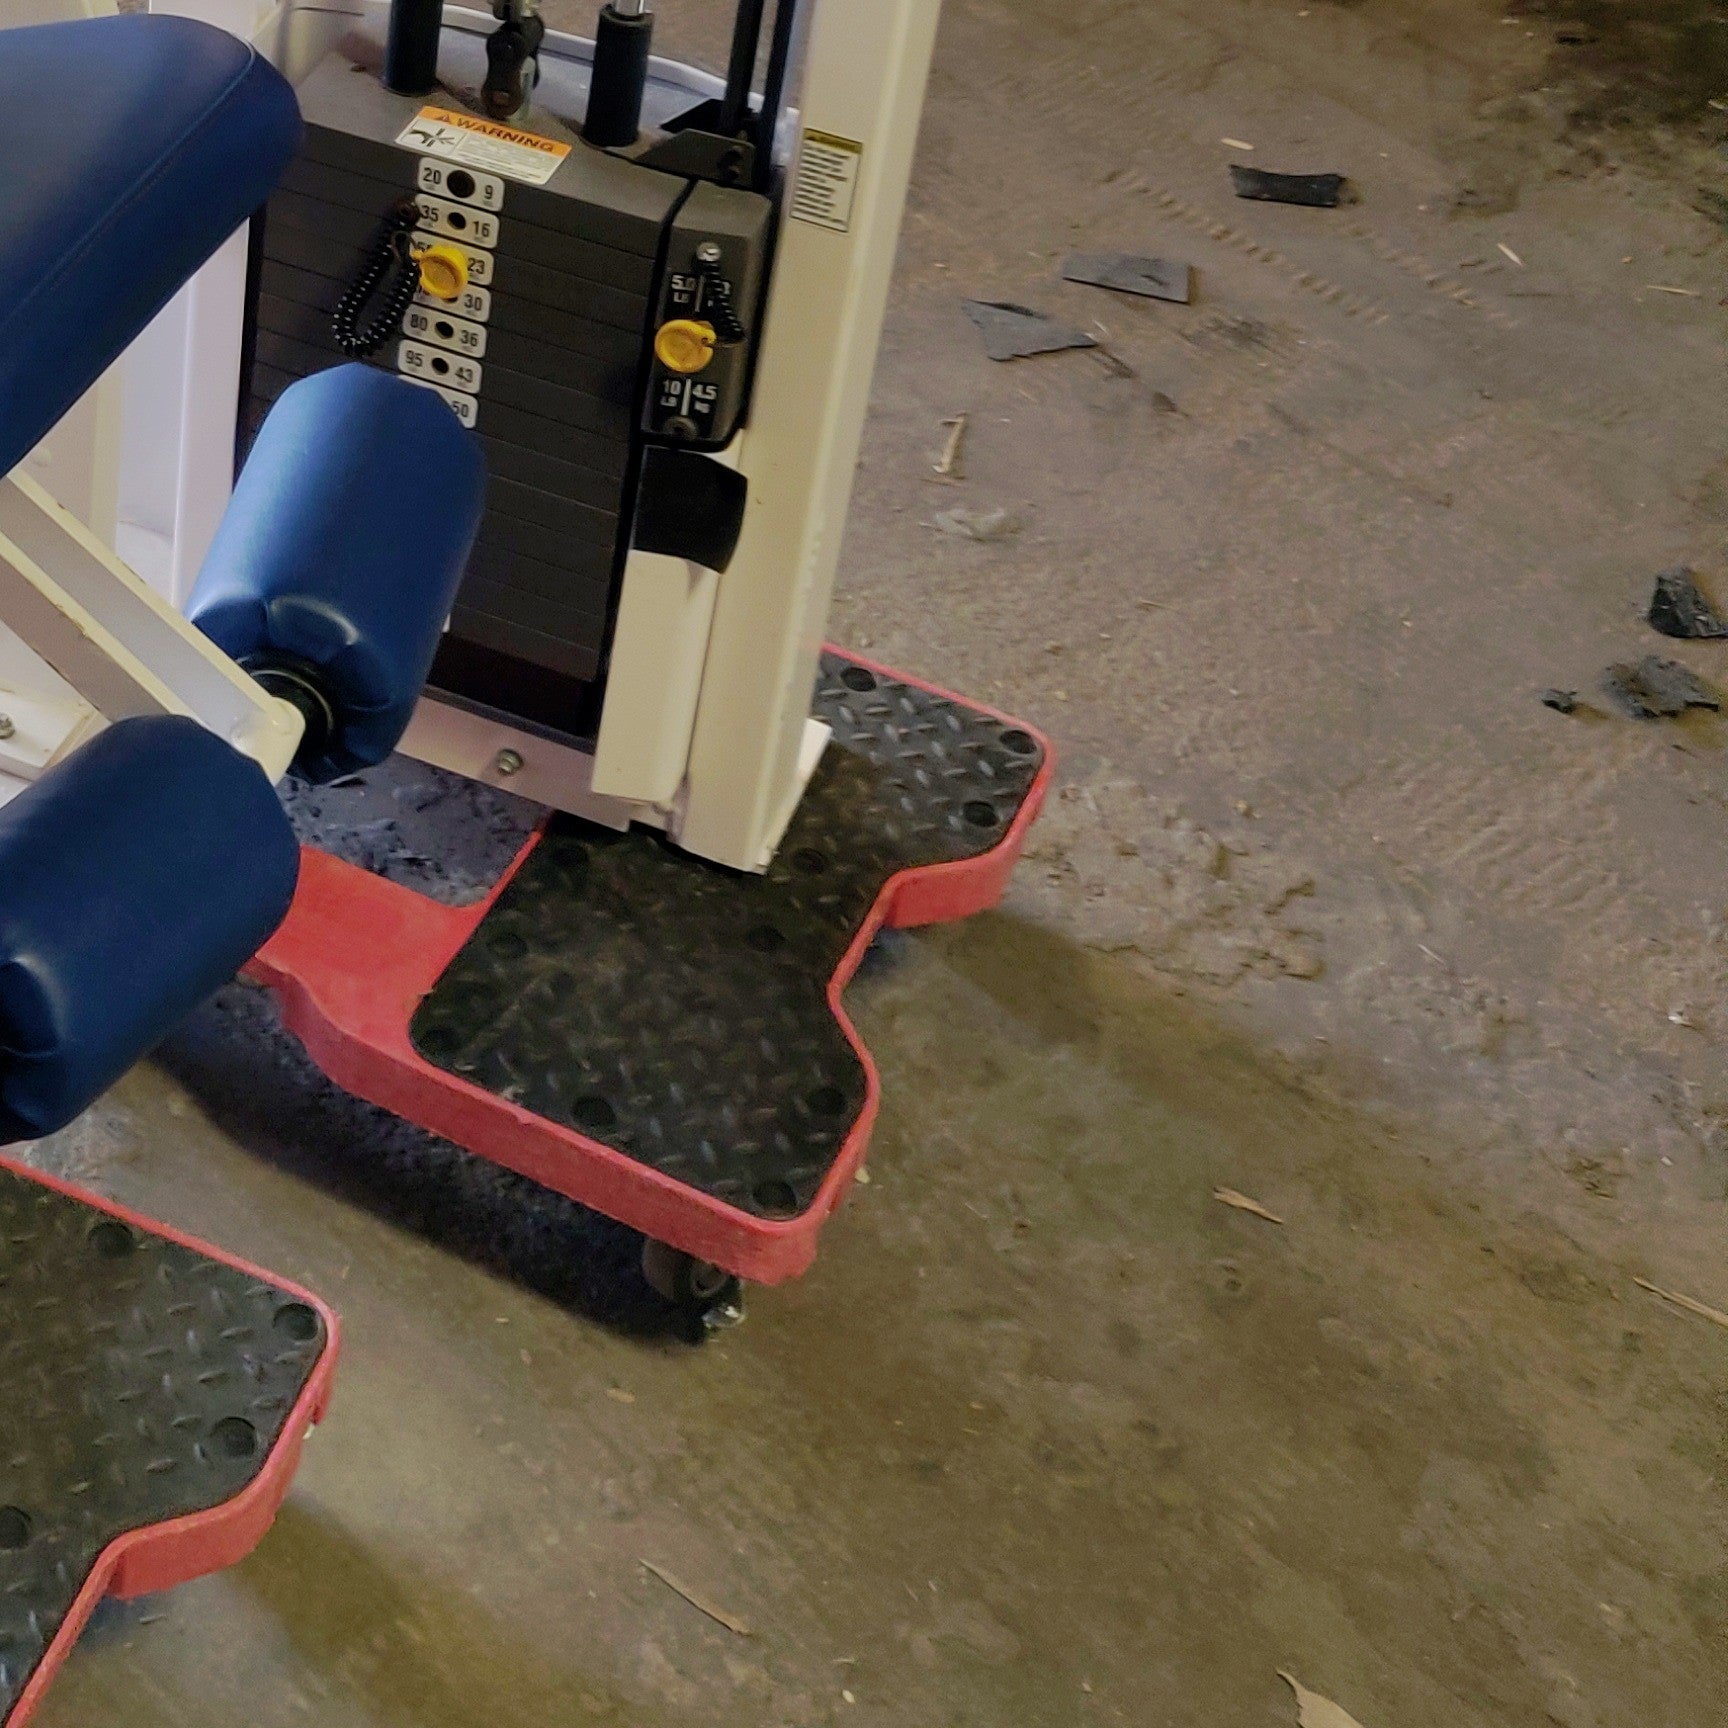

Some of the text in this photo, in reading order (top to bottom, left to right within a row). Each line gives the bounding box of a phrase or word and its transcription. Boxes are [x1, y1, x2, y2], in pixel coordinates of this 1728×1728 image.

[455, 116, 556, 153] WARNING
[423, 167, 495, 202] 20 9
[420, 204, 491, 238] 35 16
[464, 293, 483, 312] 30
[410, 313, 479, 348] 80 36
[405, 349, 475, 384] 95 43
